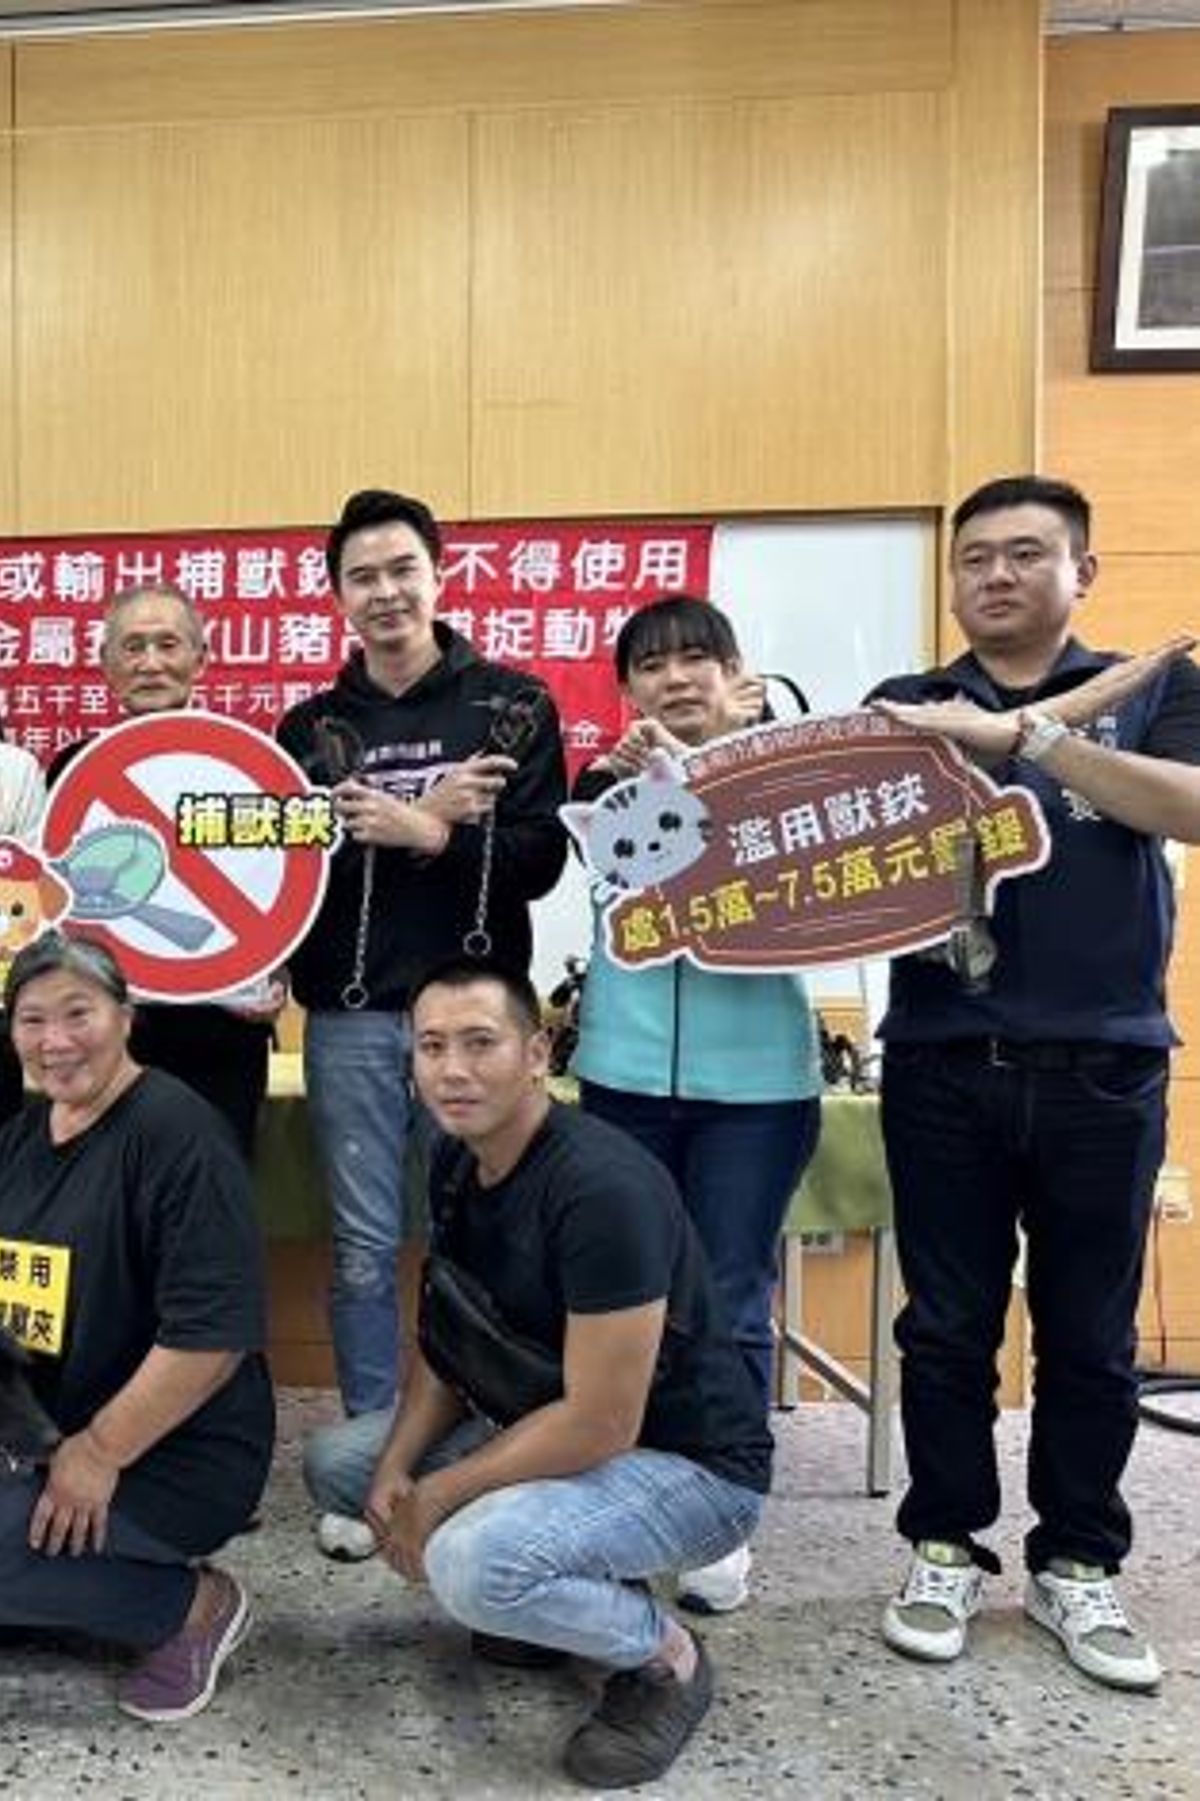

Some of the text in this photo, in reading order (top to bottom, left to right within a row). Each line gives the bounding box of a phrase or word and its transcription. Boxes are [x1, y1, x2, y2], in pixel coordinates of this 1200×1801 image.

[178, 795, 336, 848] 捕獸鋏
[727, 772, 931, 867] 濫用獸鋏
